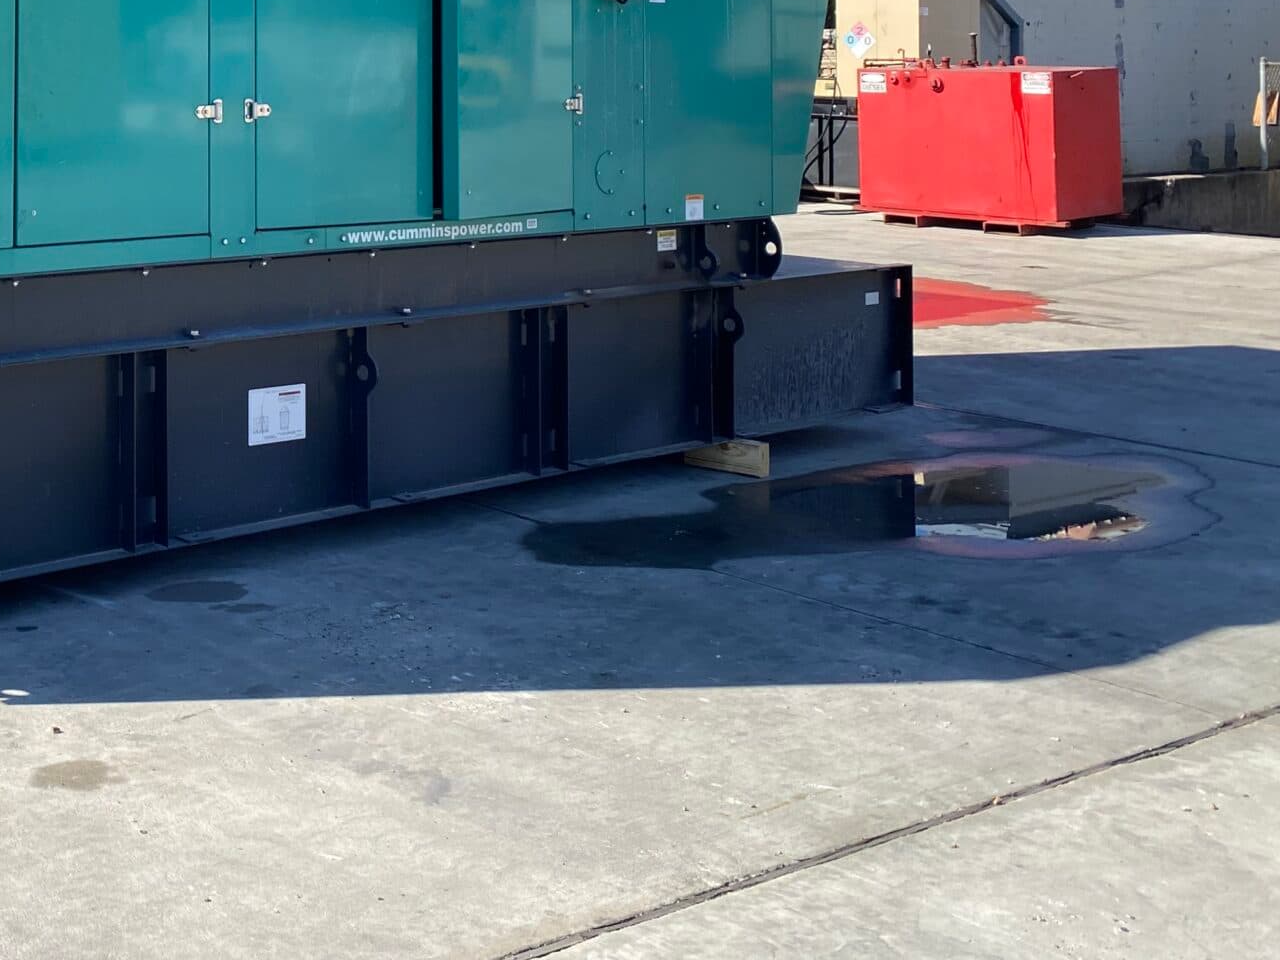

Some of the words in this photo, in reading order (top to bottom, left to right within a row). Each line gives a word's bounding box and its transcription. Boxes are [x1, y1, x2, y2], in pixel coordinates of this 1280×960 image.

[855, 26, 864, 36] 2
[847, 35, 855, 45] 0
[864, 36, 871, 45] 0
[347, 220, 523, 244] www.cumminspower.com
